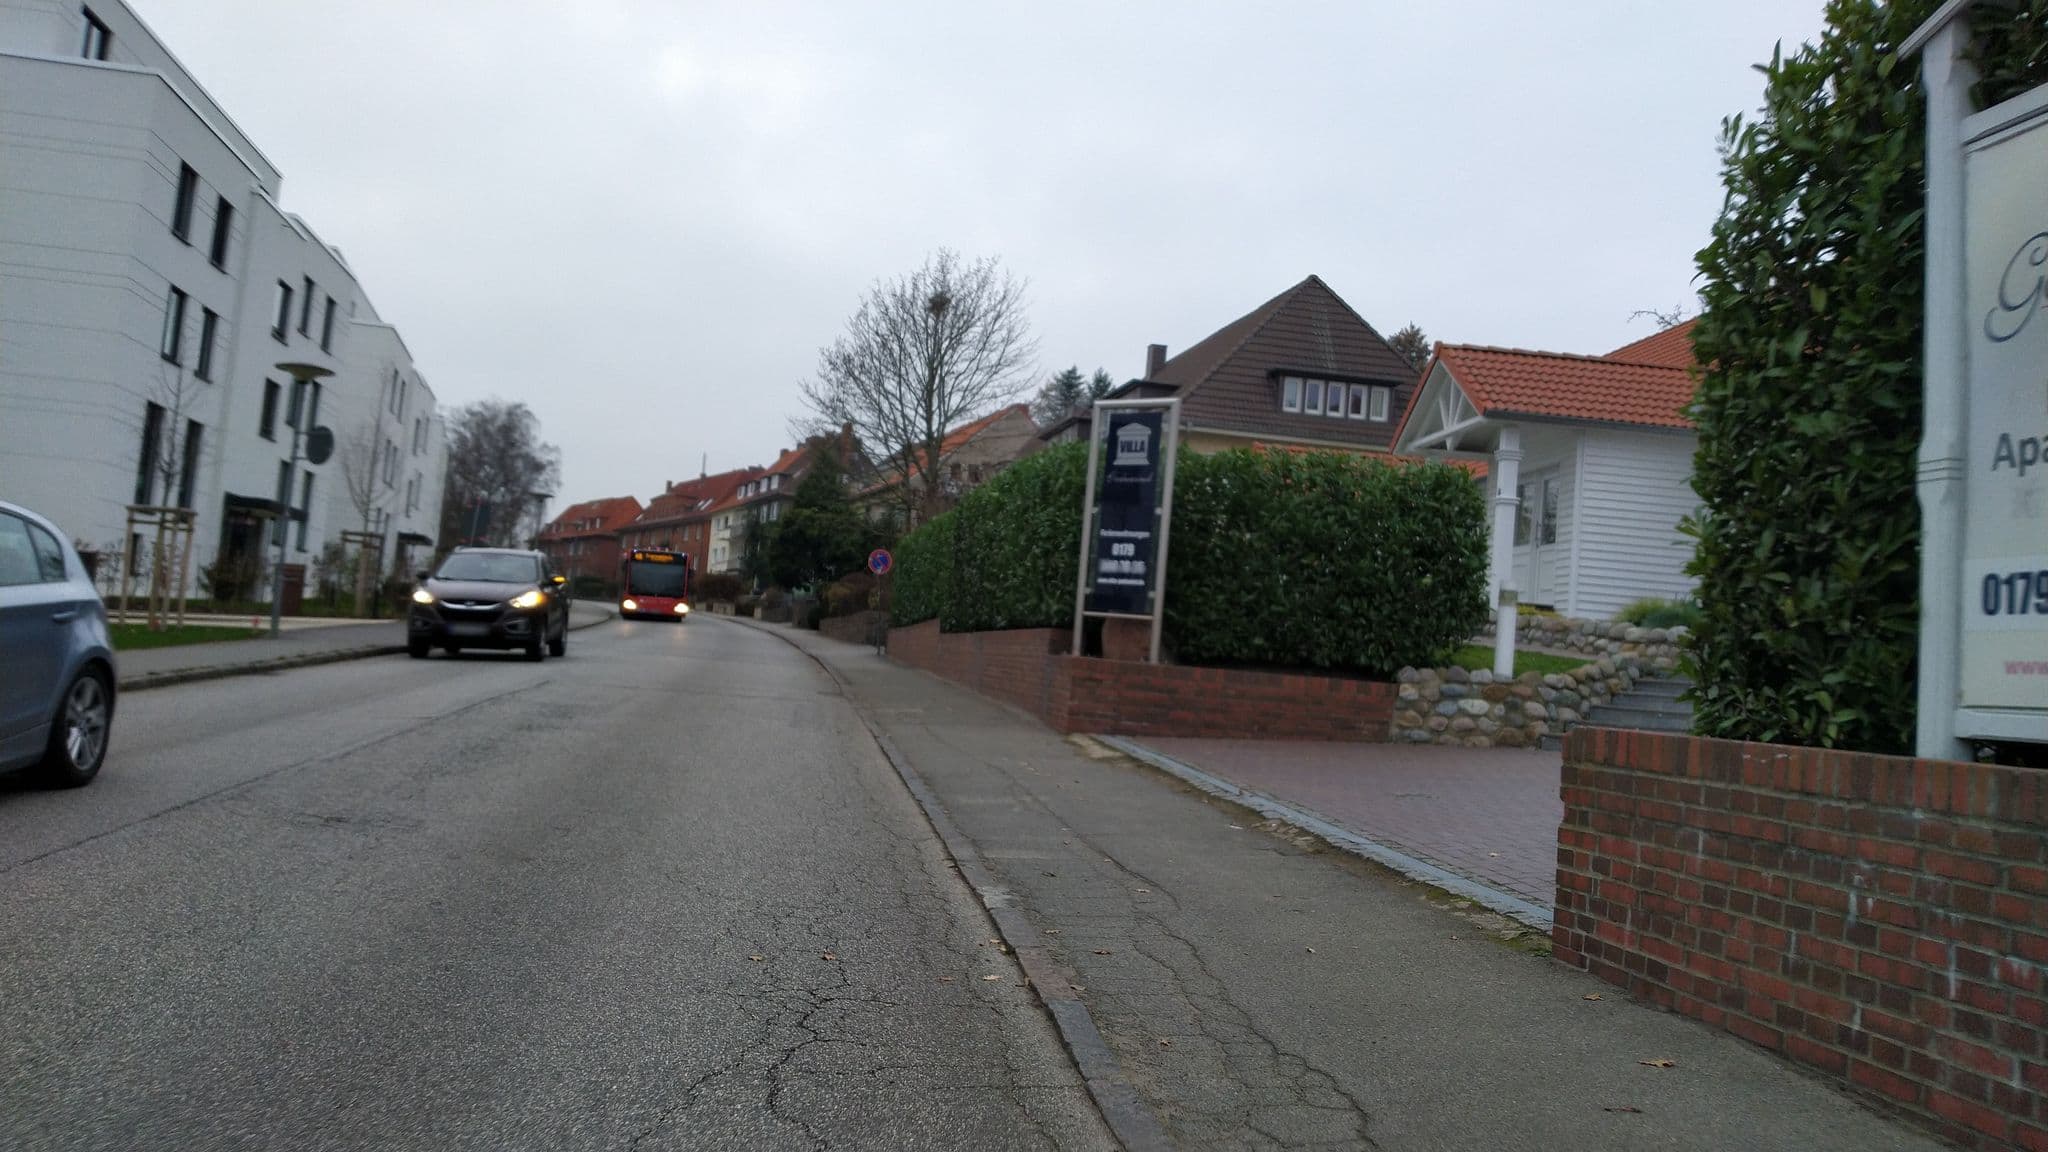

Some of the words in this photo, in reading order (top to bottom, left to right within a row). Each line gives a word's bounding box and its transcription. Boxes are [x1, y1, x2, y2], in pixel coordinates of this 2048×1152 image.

[1120, 440, 1145, 453] VILLA
[1112, 543, 1135, 555] 0179
[1982, 570, 2048, 616] 0179
